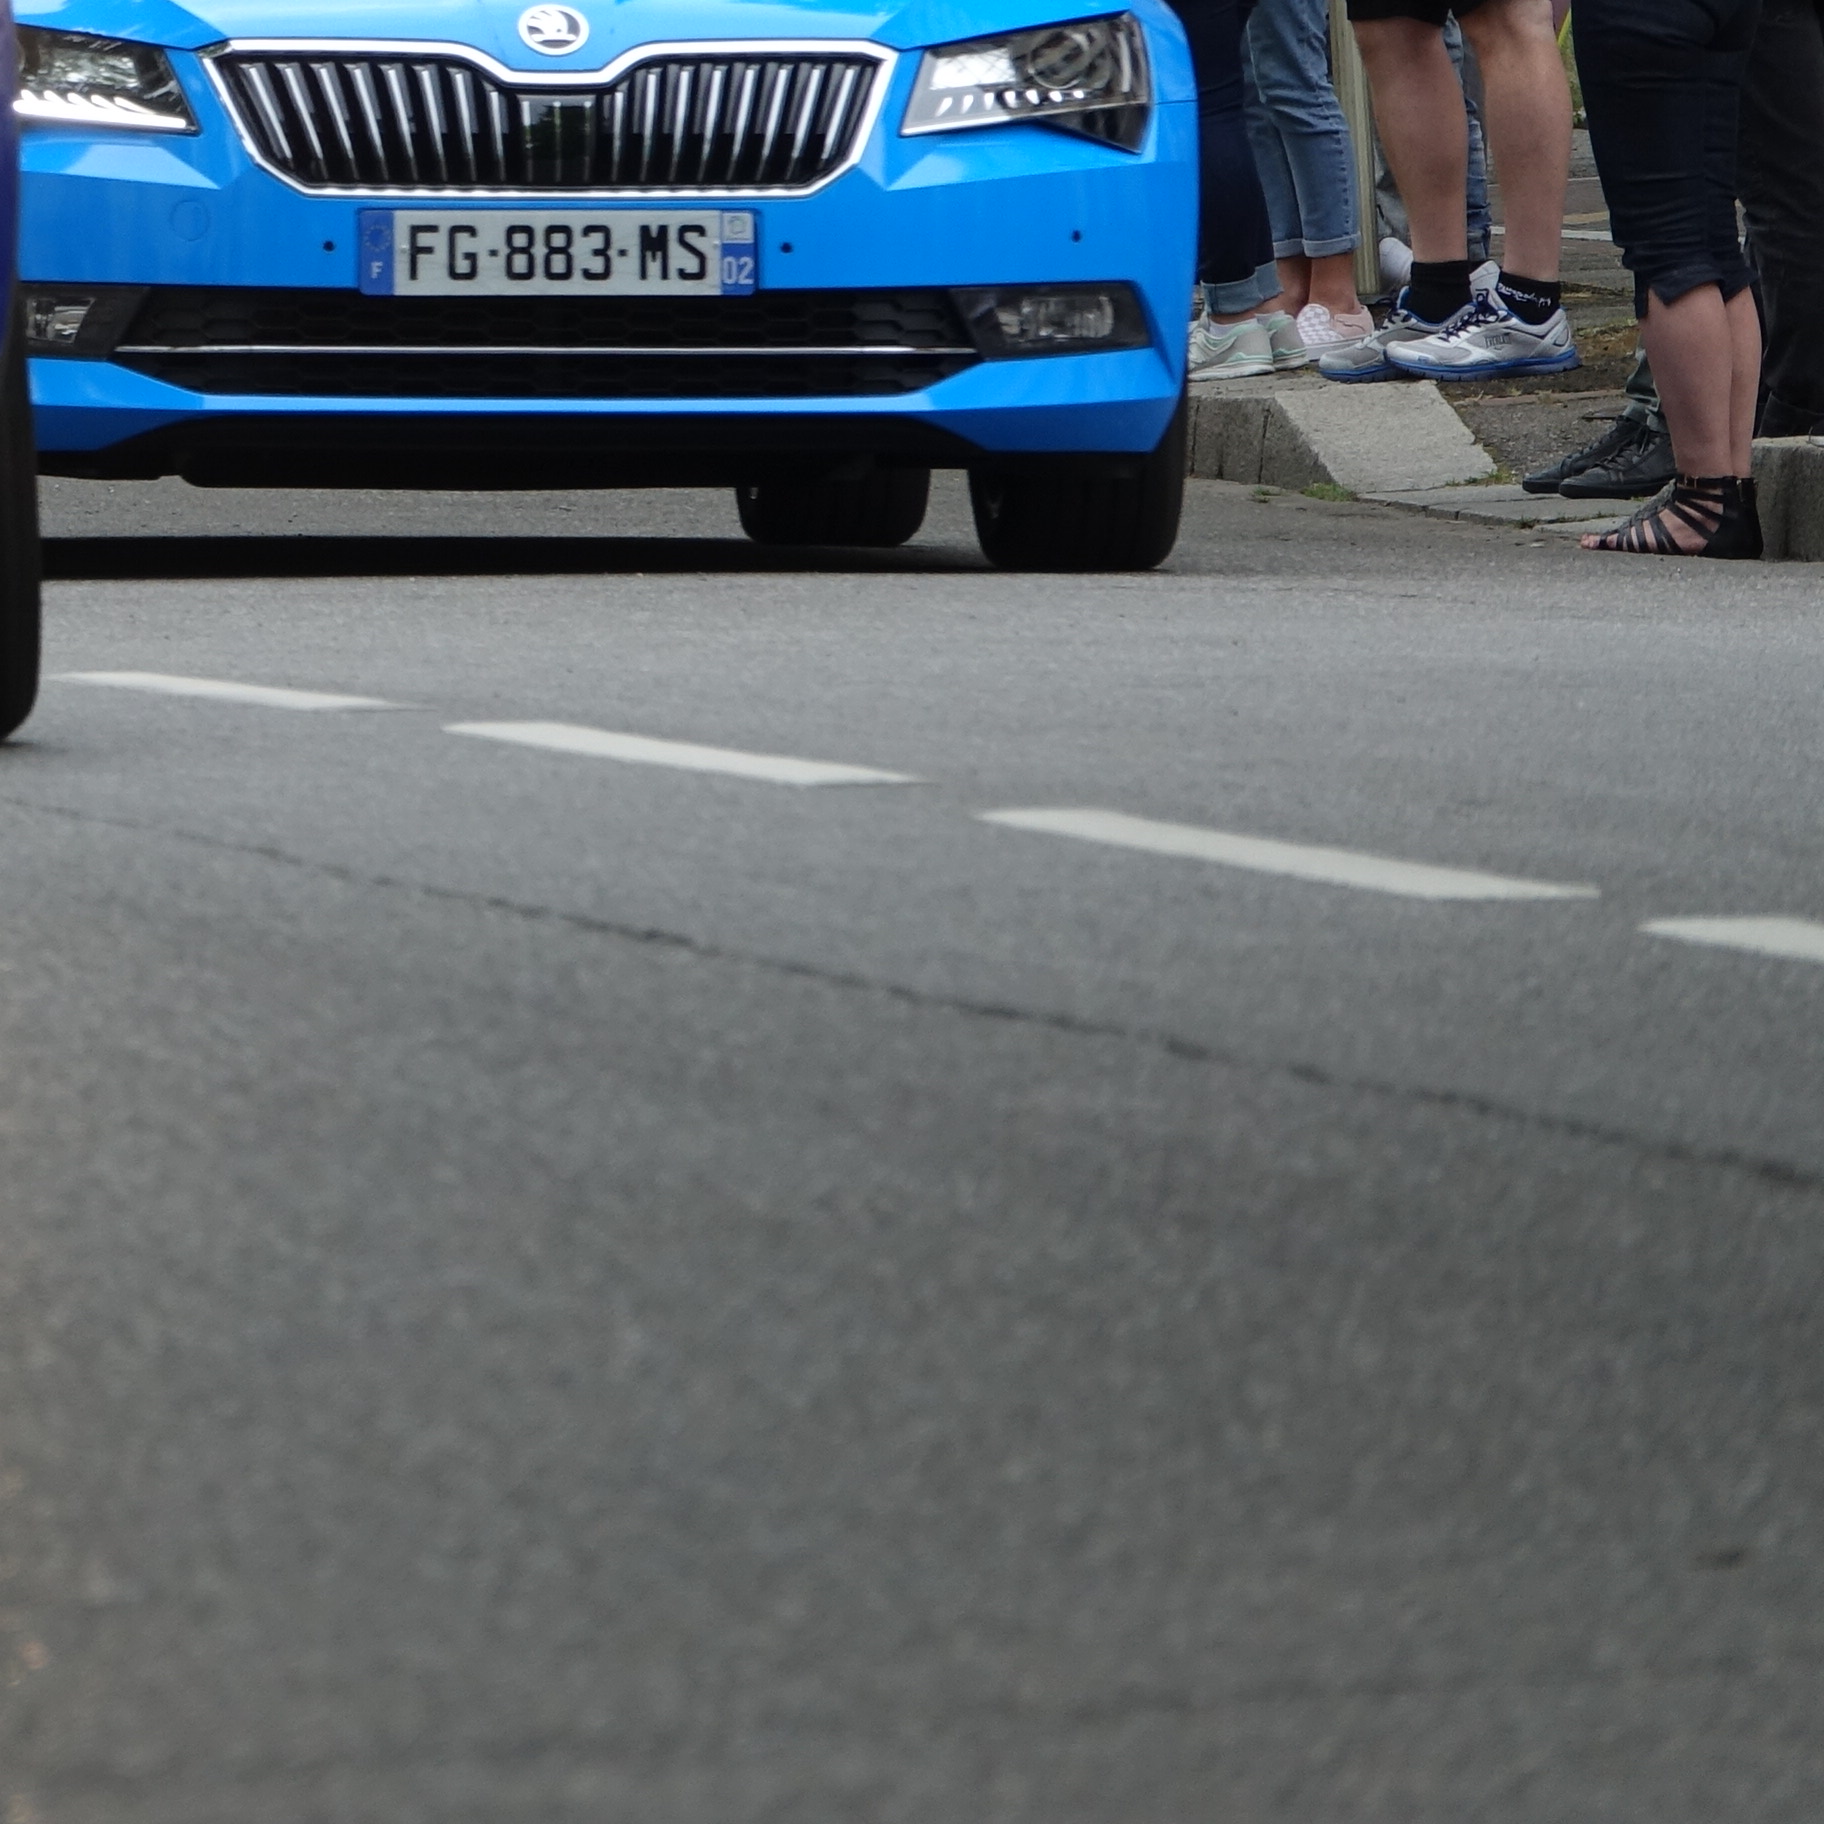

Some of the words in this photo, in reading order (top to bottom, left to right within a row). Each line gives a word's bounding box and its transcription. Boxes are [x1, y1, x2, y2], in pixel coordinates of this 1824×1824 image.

[408, 224, 709, 282] FG-883-MS
[370, 261, 383, 279] F
[722, 256, 754, 285] 02
